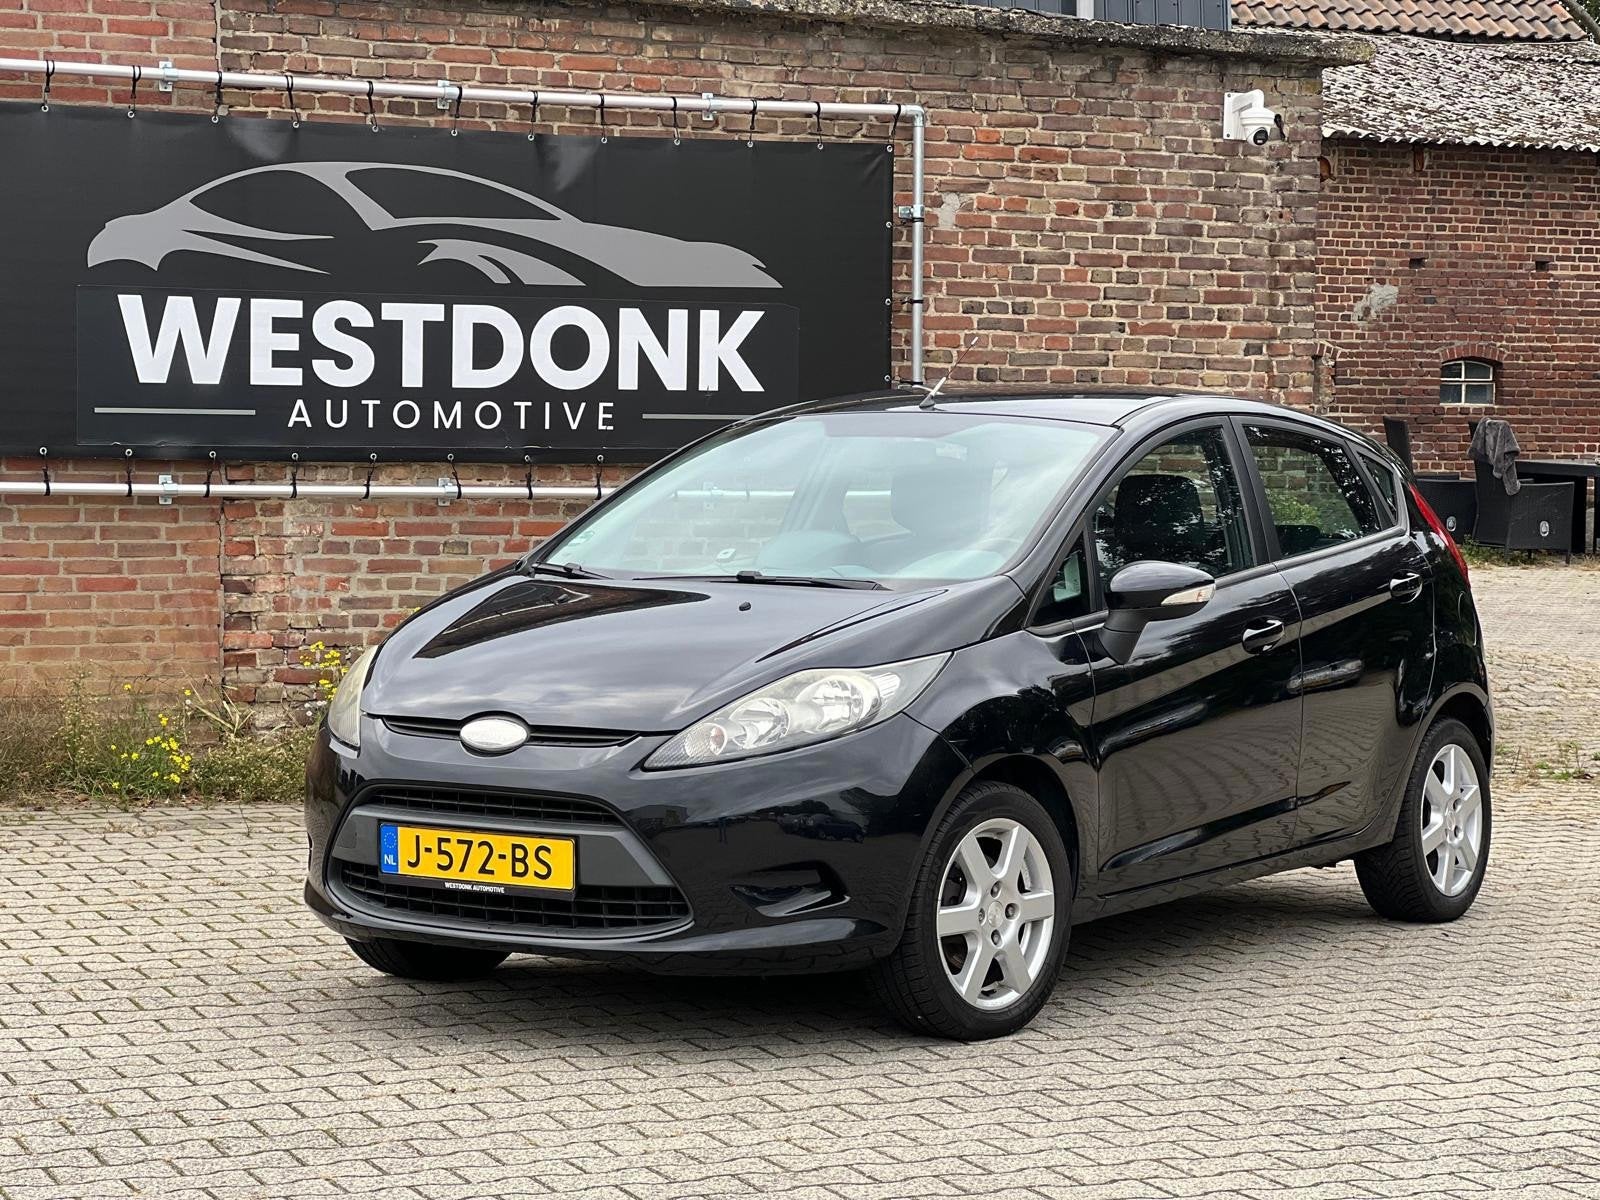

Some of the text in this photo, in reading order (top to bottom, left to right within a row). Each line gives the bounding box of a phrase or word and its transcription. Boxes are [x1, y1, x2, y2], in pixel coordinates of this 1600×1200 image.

[117, 294, 765, 392] WESTDONK
[287, 399, 614, 430] AUTOMOTIVE
[384, 854, 397, 866] NL
[407, 834, 553, 880] J-572-BS
[444, 881, 505, 894] WESTDONK AUTOMOTIVE
